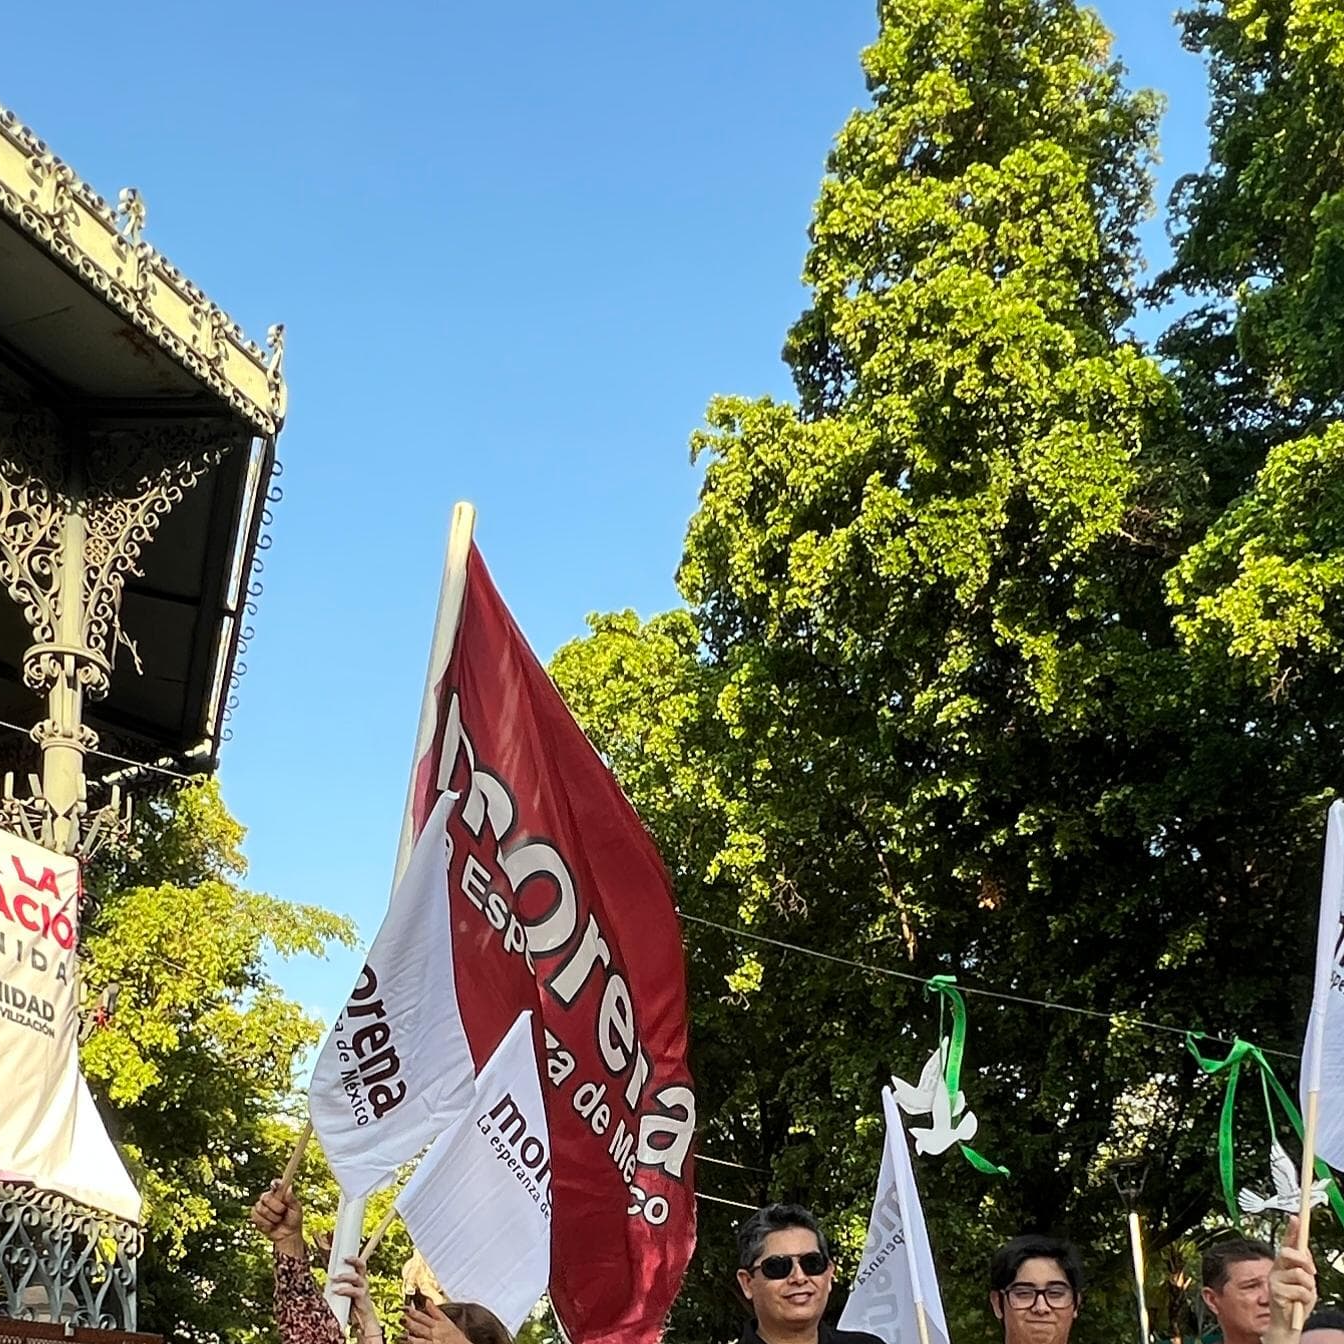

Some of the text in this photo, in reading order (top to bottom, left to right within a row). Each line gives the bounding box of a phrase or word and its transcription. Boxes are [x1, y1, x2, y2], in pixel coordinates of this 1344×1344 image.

[11, 855, 62, 901] LA
[336, 1039, 354, 1062] de
[340, 1068, 369, 1126] México
[573, 1082, 611, 1135] de
[476, 1114, 492, 1136] La
[490, 1135, 541, 1203] esperanza
